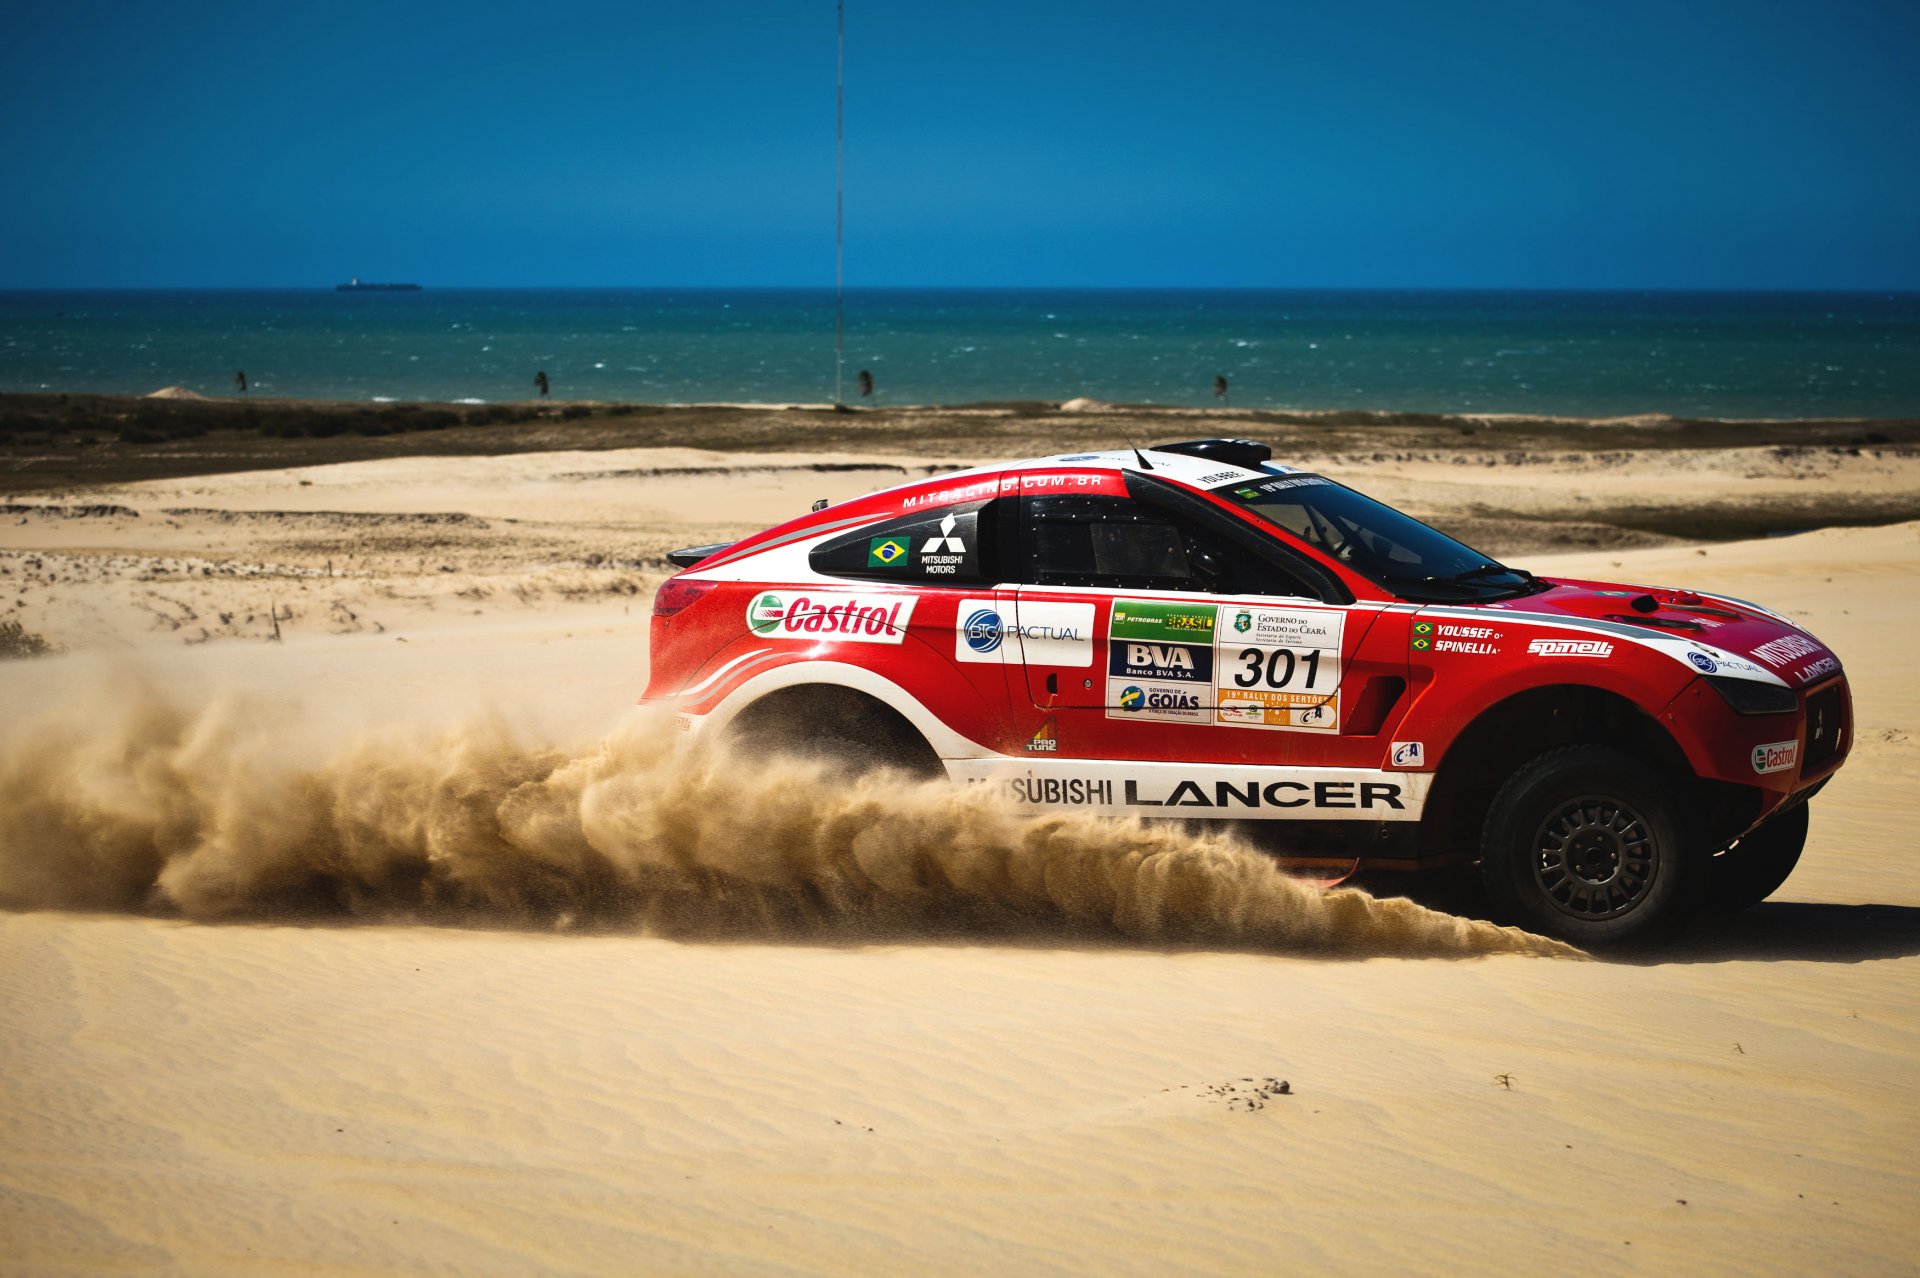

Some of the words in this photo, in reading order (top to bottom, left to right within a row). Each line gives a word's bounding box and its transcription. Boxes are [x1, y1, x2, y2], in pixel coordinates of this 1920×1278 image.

[921, 555, 963, 565] MITSUBISHI
[926, 565, 956, 574] MOTORS
[784, 597, 903, 636] Castrol
[1127, 616, 1163, 624] PETROBRAS
[970, 623, 999, 640] BTG
[1007, 625, 1085, 642] PACTUAL
[1437, 625, 1494, 639] YOUSSEF
[1127, 643, 1195, 670] BVA
[1435, 640, 1493, 655] SPINELLI
[1749, 634, 1824, 669] MITSUBISHI
[1126, 668, 1153, 676] Banco
[1156, 669, 1174, 677] BVA
[1176, 671, 1195, 679] S.A.
[1234, 647, 1321, 689] 301
[1794, 657, 1840, 683] LANCER
[1148, 691, 1200, 711] GOIÁS
[1226, 691, 1240, 699] 19º
[1243, 692, 1268, 700] RALLY
[1271, 693, 1288, 702] DOS
[1290, 694, 1329, 704] SERTÕES
[1766, 745, 1796, 768] Castrol
[1125, 780, 1406, 810] LANCER
